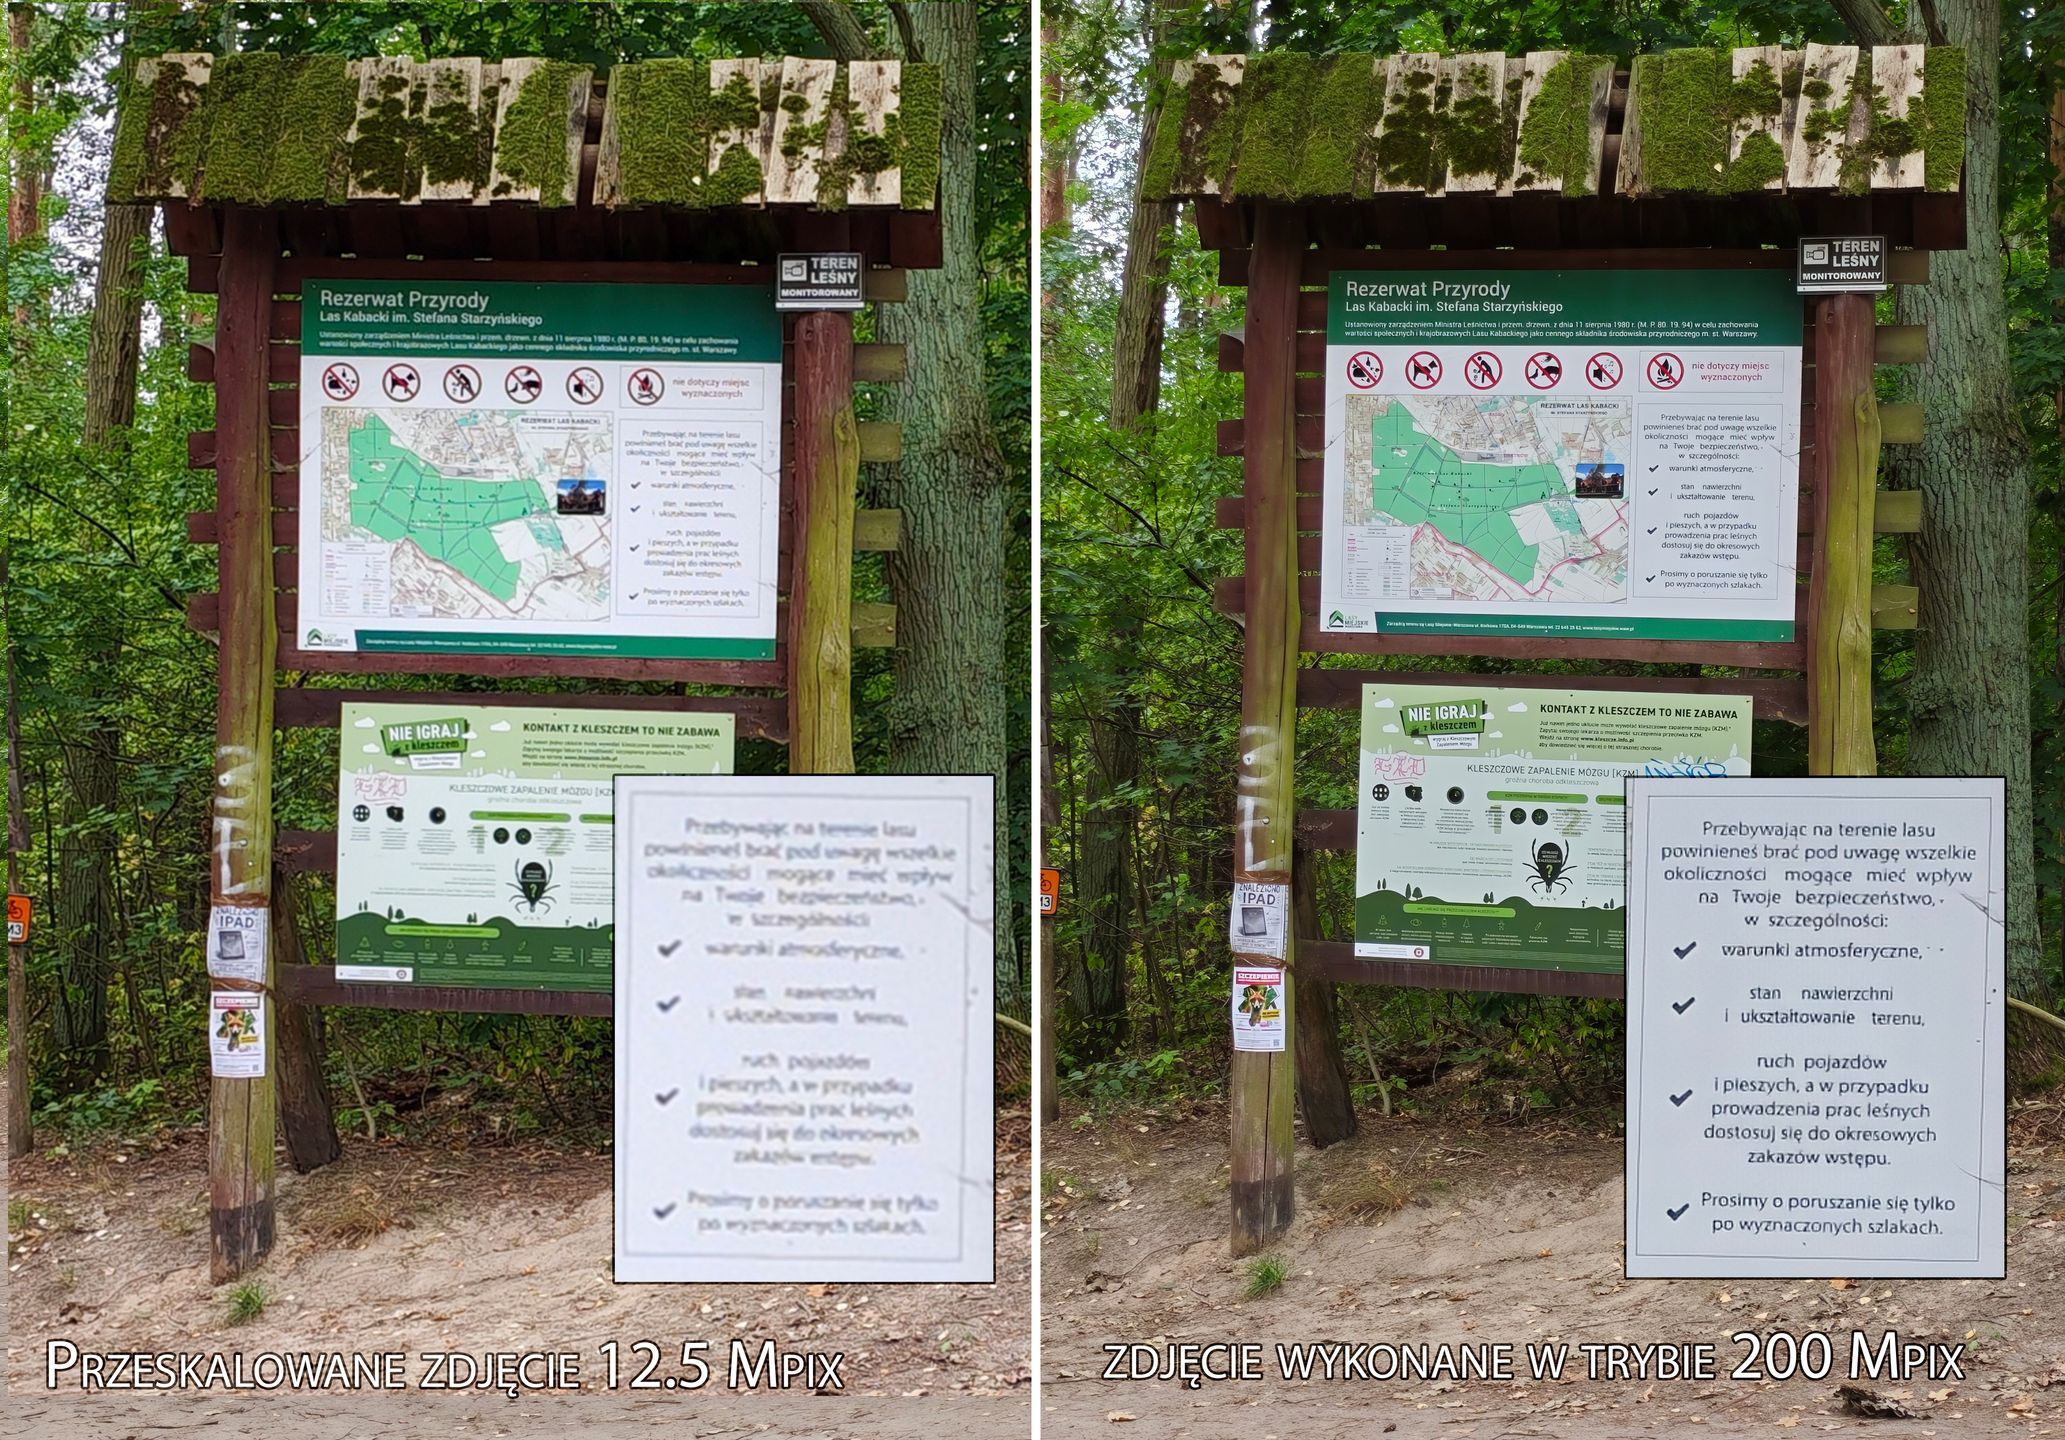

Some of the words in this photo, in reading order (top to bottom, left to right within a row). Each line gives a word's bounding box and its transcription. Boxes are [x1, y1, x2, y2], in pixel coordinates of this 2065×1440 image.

[1833, 240, 1880, 252] TEREN
[811, 257, 857, 269] TEREN
[1833, 253, 1879, 267] LEŚNY
[811, 270, 857, 284] LEŚNY
[1803, 272, 1881, 280] MONITOROWANY
[781, 289, 858, 297] MONITOROWANY
[1347, 281, 1426, 296] Rezerwat
[1433, 280, 1510, 300] Przyrody
[321, 290, 404, 307] Rezerwat
[409, 291, 489, 312] Przyrody
[1346, 302, 1365, 311] Las
[1369, 300, 1412, 311] Kabacki
[1416, 301, 1432, 311] im.
[1436, 301, 1479, 311] Stefana
[1483, 301, 1563, 314] Starzyńskiego
[320, 311, 341, 322] Las
[343, 311, 389, 322] Kabacki
[392, 311, 410, 323] im.
[413, 311, 458, 324] Stefana
[461, 312, 542, 327] Starzyńskiego
[1388, 321, 1434, 329] zarządzeniem
[1614, 321, 1630, 329] 1980
[1670, 321, 1680, 329] 19.
[1681, 321, 1693, 329] 94)
[1419, 329, 1471, 338] krajobrazowych
[1490, 330, 1529, 338] Kabackiego
[1529, 330, 1544, 338] jako
[1648, 330, 1700, 338] przyrodniczego
[1692, 361, 1704, 370] nie
[1707, 362, 1740, 371] dotyczy
[1742, 362, 1768, 372] miejsc
[1700, 372, 1762, 383] wyznaczonych
[1408, 707, 1432, 721] NIE
[1435, 704, 1477, 719] IGRAJ
[1540, 704, 1587, 714] KONTAKT
[1589, 706, 1595, 714] Z
[1598, 706, 1656, 716] KLESZCZEM
[1659, 708, 1672, 717] TO
[1675, 709, 1692, 717] NIE
[1694, 709, 1738, 719] ZABAWA
[389, 726, 413, 741] NIE
[416, 723, 460, 739] IGRAJ
[523, 723, 570, 733] KONTAKT
[572, 724, 579, 733] Z
[581, 724, 639, 734] KLESZCZEM
[642, 726, 655, 735] TO
[657, 727, 674, 736] NIE
[677, 727, 720, 737] ZABAWA
[1430, 721, 1477, 731] kleszczem
[1467, 765, 1525, 774] KLESZCZOWE
[1528, 766, 1575, 776] ZAPALENIE
[1578, 768, 1609, 777] MÓZGU
[1612, 768, 1640, 779] [KZM]
[1528, 776, 1554, 784] choroba
[1555, 777, 1599, 786] odkleszczowa
[1703, 821, 1807, 838] Przebywając
[1813, 825, 1833, 837] na
[1839, 823, 1897, 837] terenie
[1902, 822, 1935, 837] lasu
[1661, 844, 1758, 861] powinieneś
[1764, 844, 1799, 859] brać
[1805, 845, 1838, 862] pod
[1844, 848, 1900, 863] uwagę
[1905, 844, 1976, 860] wszelkie
[1664, 866, 1766, 881] okoliczności
[1785, 870, 1852, 886] mogące
[1867, 868, 1905, 882] mieć
[1917, 868, 1971, 886] wpływ
[1240, 884, 1281, 893] ZNALEZIONO
[1243, 892, 1276, 905] IPAD
[1699, 892, 1719, 904] na
[1732, 889, 1781, 907] Twoje
[1795, 890, 1935, 907] bezpieczeństwo,
[220, 916, 254, 928] IPAD
[1744, 916, 1759, 926] w
[1769, 913, 1888, 930] szczególności:
[1722, 942, 1789, 957] warunki
[1795, 942, 1922, 961] atmosferyczne,
[1749, 987, 1781, 1000] stan
[1801, 986, 1893, 1001] nawierzchni
[1725, 1009, 1728, 1022] i
[1741, 1009, 1856, 1024] ukształtowanie
[1871, 1012, 1925, 1026] terenu,
[1757, 1053, 1795, 1068] ruch
[1804, 1054, 1887, 1071] pojazdów
[1714, 1078, 1719, 1091] i
[1723, 1078, 1800, 1095] pieszych,
[1804, 1081, 1814, 1092] a
[1819, 1082, 1835, 1092] w
[1838, 1078, 1929, 1096] przypadku
[1711, 1101, 1820, 1118] prowadzenia
[1825, 1106, 1862, 1119] prac
[1867, 1103, 1930, 1120] leśnych
[1704, 1124, 1776, 1143] dostosuj
[1780, 1127, 1803, 1143] się
[1807, 1125, 1830, 1141] do
[1835, 1126, 1936, 1144] okresowych
[1748, 1149, 1820, 1164] zakazów
[1825, 1152, 1890, 1168] wstępu.
[1702, 1192, 1767, 1210] Prosimy
[1773, 1197, 1783, 1208] o
[1789, 1196, 1881, 1211] poruszanie
[1887, 1196, 1908, 1213] się
[1914, 1196, 1955, 1213] tylko
[1712, 1220, 1734, 1234] po
[1739, 1218, 1862, 1235] wyznaczonych
[1867, 1219, 1943, 1235] szlakach.
